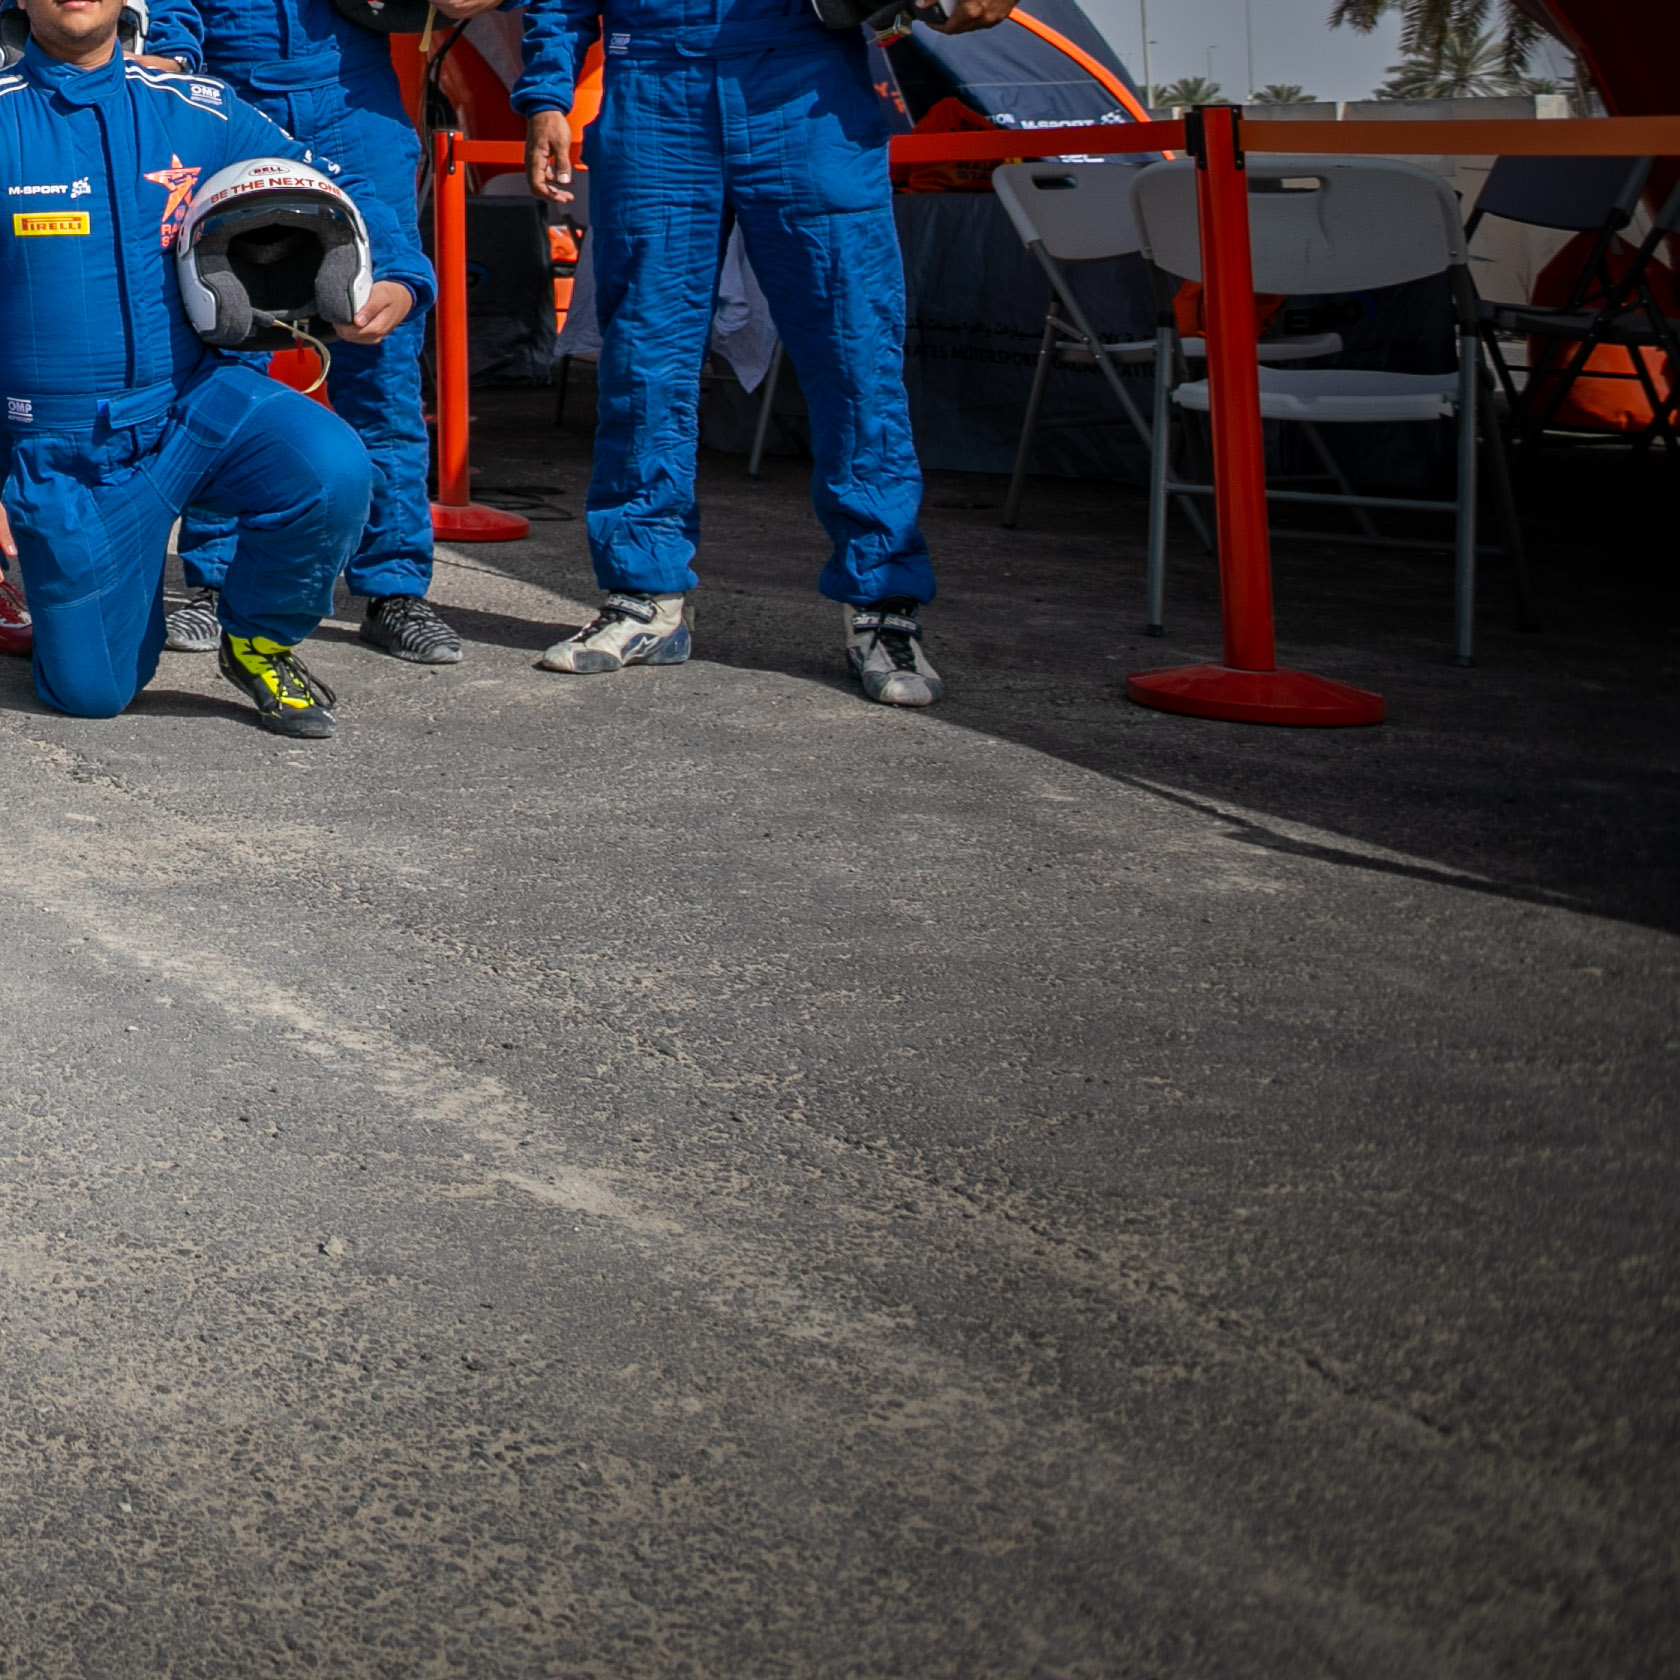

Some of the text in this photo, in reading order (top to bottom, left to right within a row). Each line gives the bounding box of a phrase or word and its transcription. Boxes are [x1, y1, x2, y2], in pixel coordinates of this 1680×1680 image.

[191, 86, 221, 98] OMP
[253, 166, 284, 174] BELL
[8, 185, 68, 196] M-SPORT
[210, 178, 341, 204] BE THE NEXT ONE
[21, 217, 82, 232] PIRELLI
[8, 401, 33, 414] OMP
